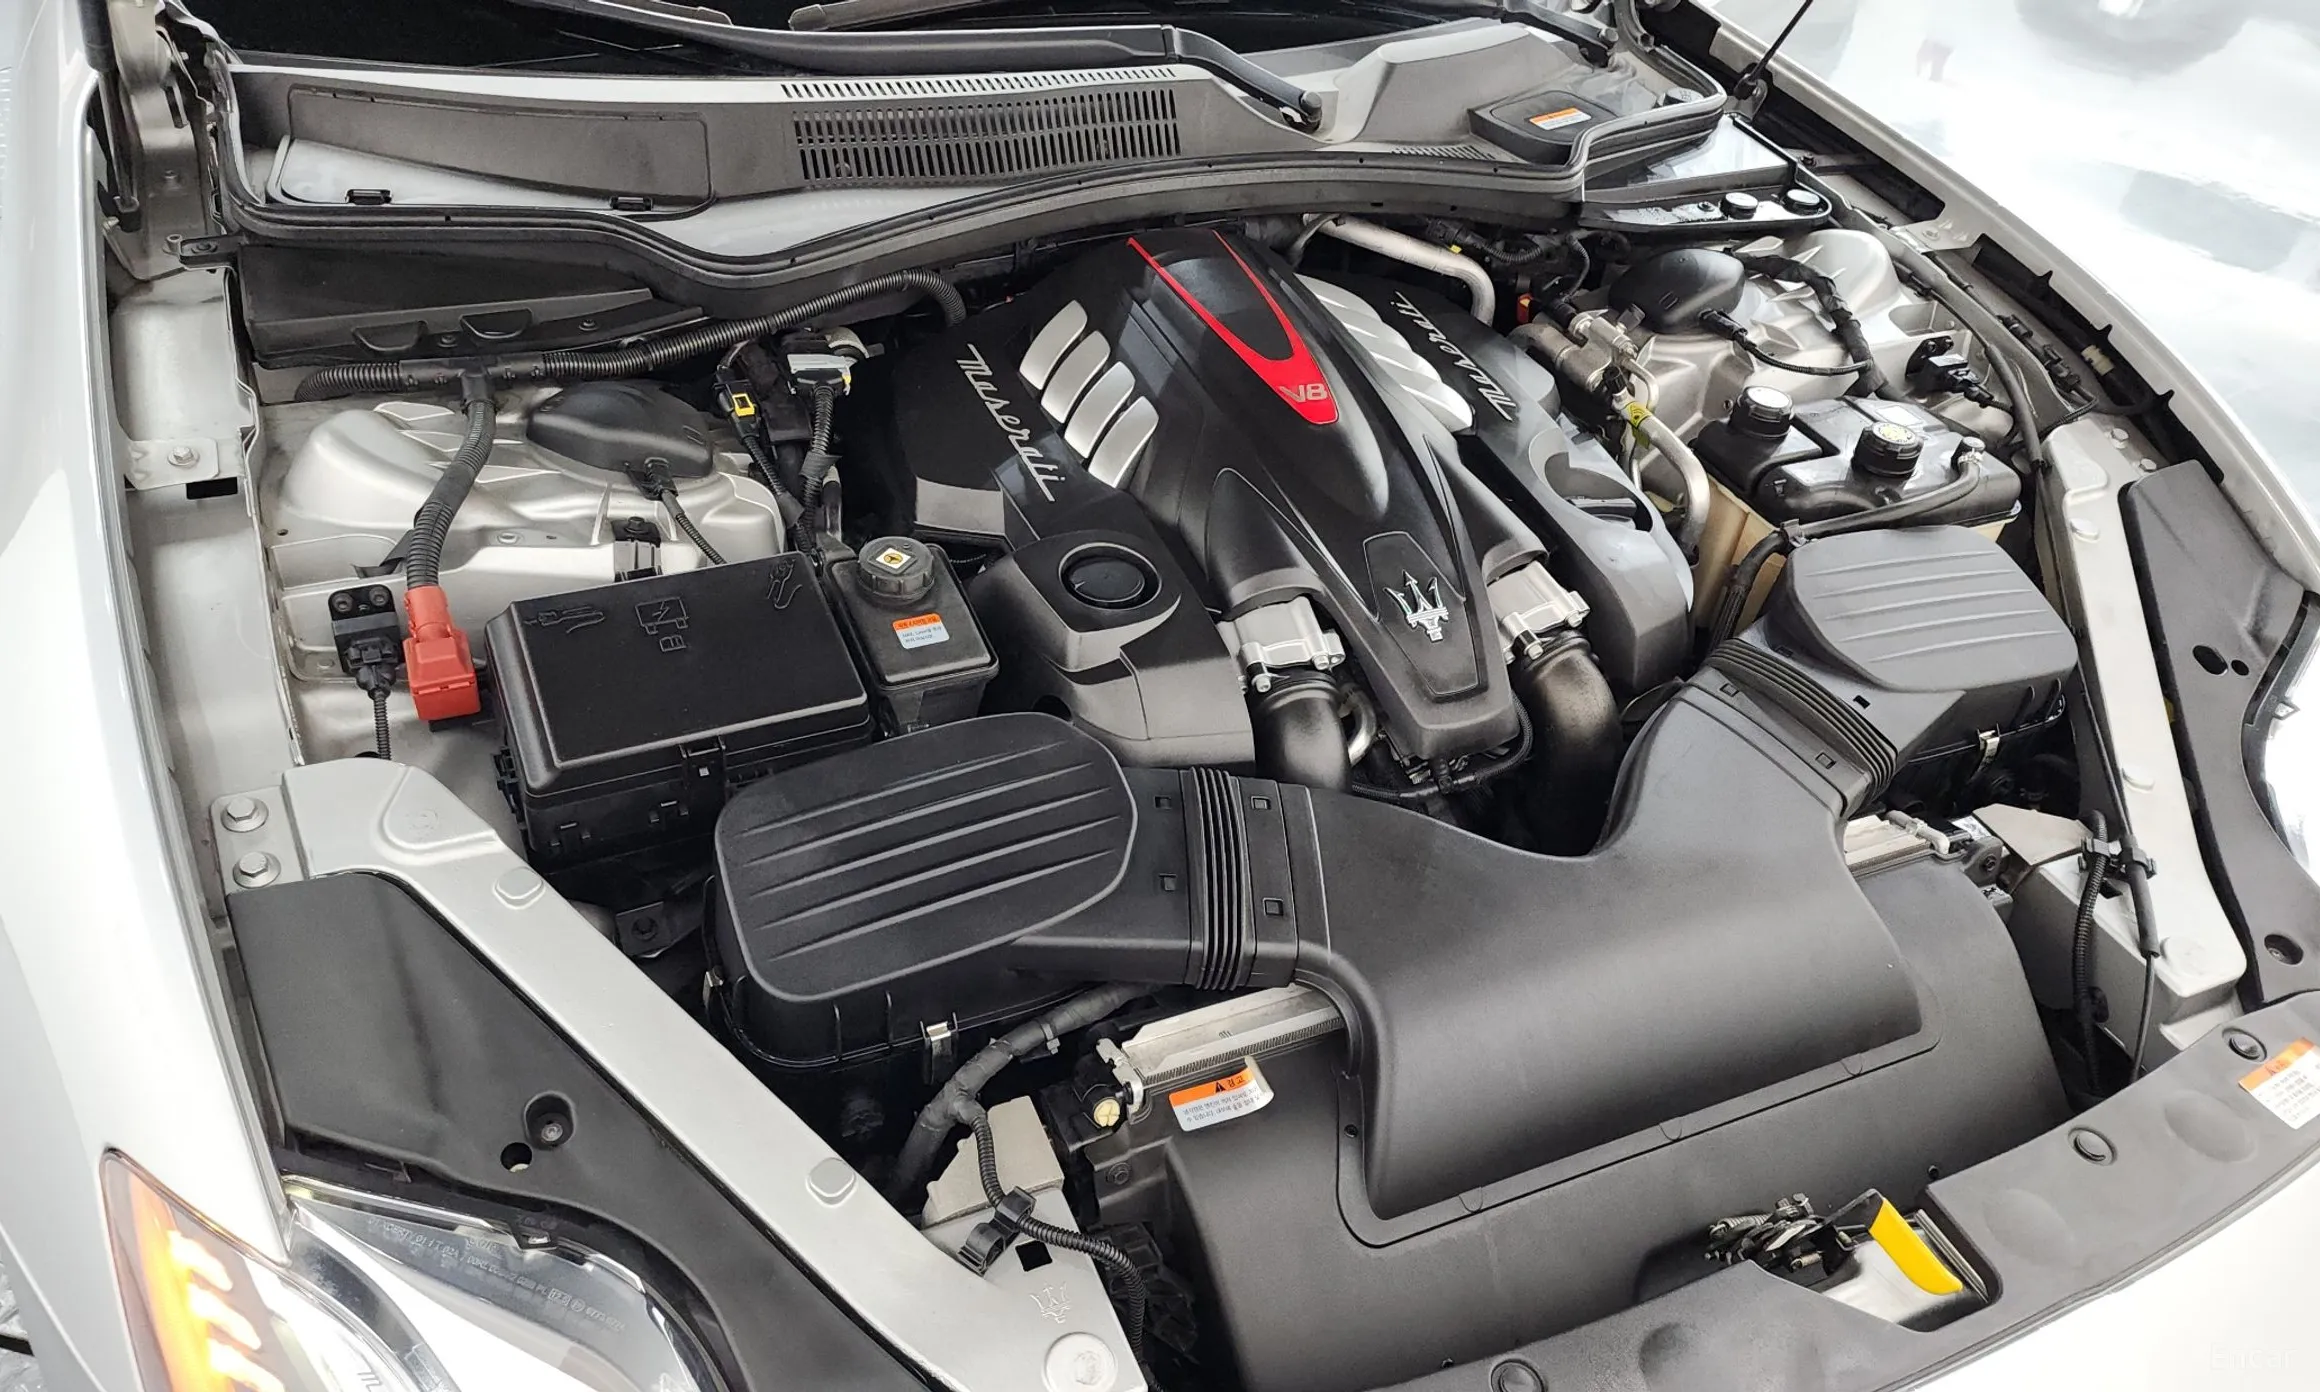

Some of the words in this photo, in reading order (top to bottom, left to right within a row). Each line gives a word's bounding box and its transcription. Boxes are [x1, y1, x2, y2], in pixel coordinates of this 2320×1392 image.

[1278, 383, 1328, 403] V8
[1390, 290, 1517, 422] Maserati
[955, 343, 1066, 502] Maserati
